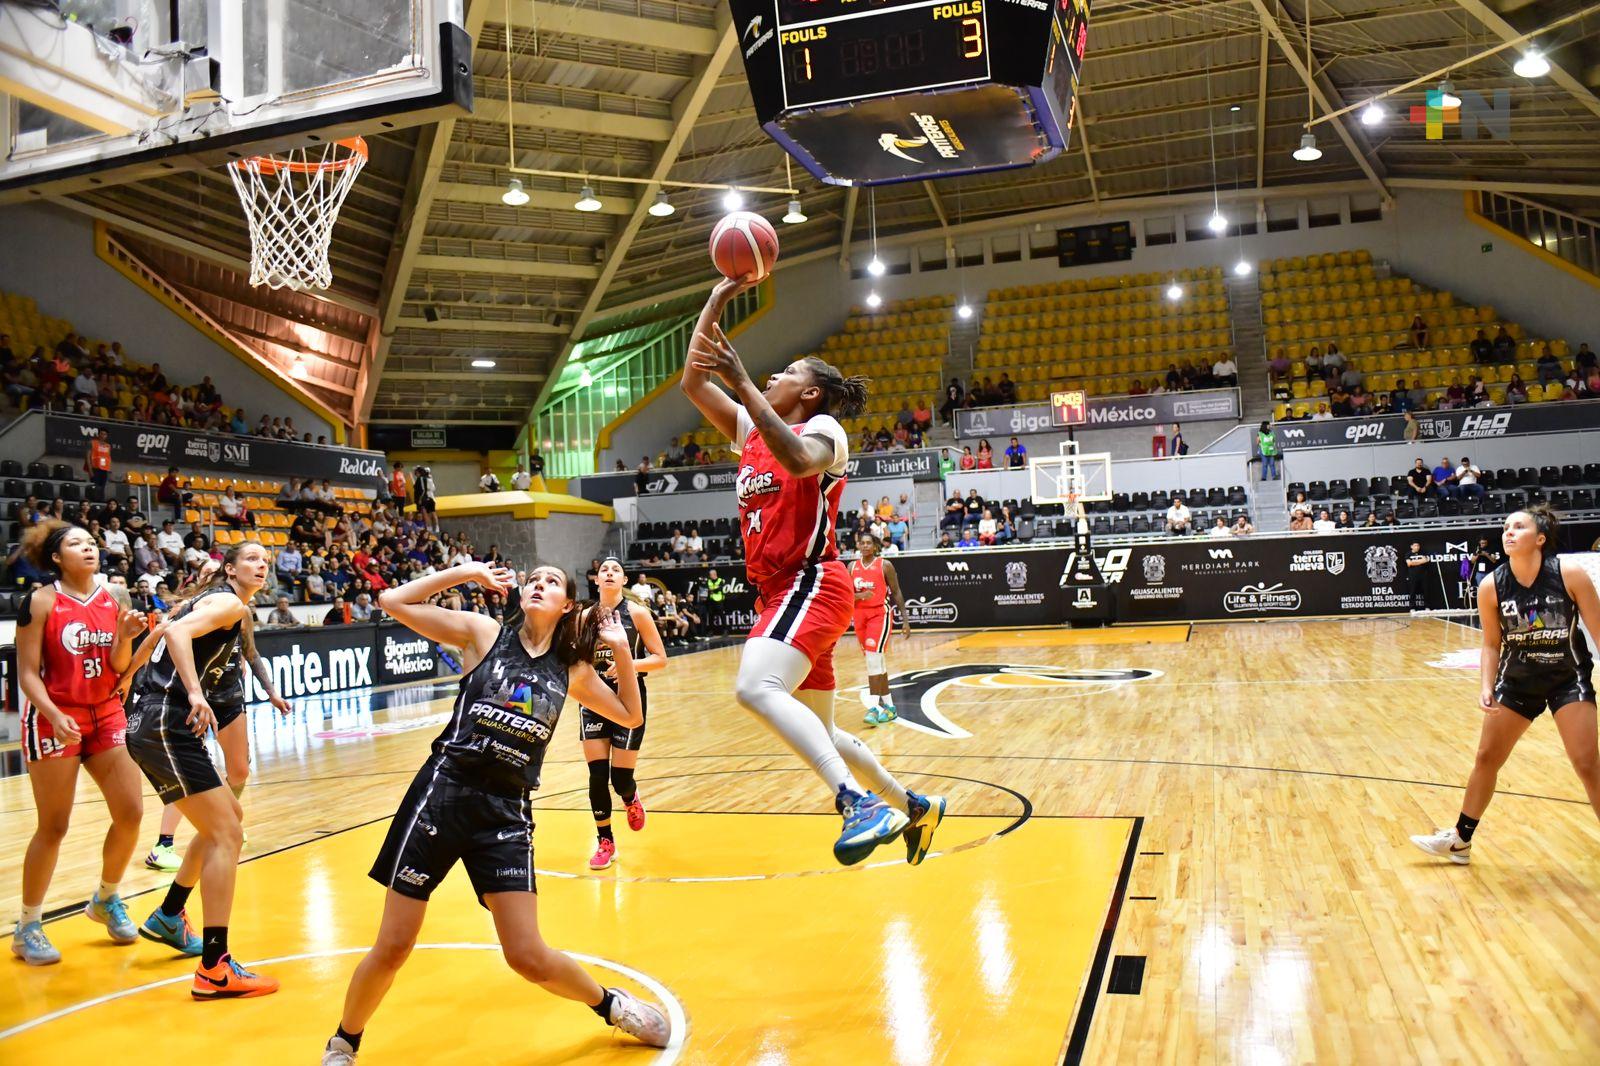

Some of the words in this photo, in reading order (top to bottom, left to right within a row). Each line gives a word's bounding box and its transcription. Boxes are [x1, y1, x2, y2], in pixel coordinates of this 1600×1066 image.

[933, 1, 983, 20] FOULS
[781, 26, 827, 45] FOULS
[962, 18, 983, 59] 3
[804, 47, 812, 80] 1
[1010, 413, 1050, 433] giga
[1091, 405, 1156, 423] México
[1462, 412, 1512, 431] H2O
[1460, 428, 1506, 438] POWER
[876, 457, 930, 474] Fairfield
[1181, 562, 1230, 571] MERIDIAM
[1292, 554, 1324, 563] tierra
[1289, 562, 1325, 572] nueva
[922, 574, 967, 582] MERIDIAM
[994, 593, 1044, 601] AGUASCALIENTES
[1130, 587, 1183, 596] AGUASCALIENTES
[1227, 595, 1246, 604] Life
[1249, 595, 1257, 603] &
[1260, 593, 1297, 603] Fitness
[1372, 586, 1394, 595] IDEA
[921, 606, 954, 615] Fitness
[1500, 600, 1518, 616] 23
[79, 629, 114, 645] Rojas
[384, 639, 429, 660] gigante
[83, 658, 102, 679] 35
[393, 657, 434, 675] México
[492, 659, 505, 680] 4
[468, 702, 552, 740] PANTERAS
[400, 865, 430, 882] H2O
[496, 868, 527, 877] Fairfield
